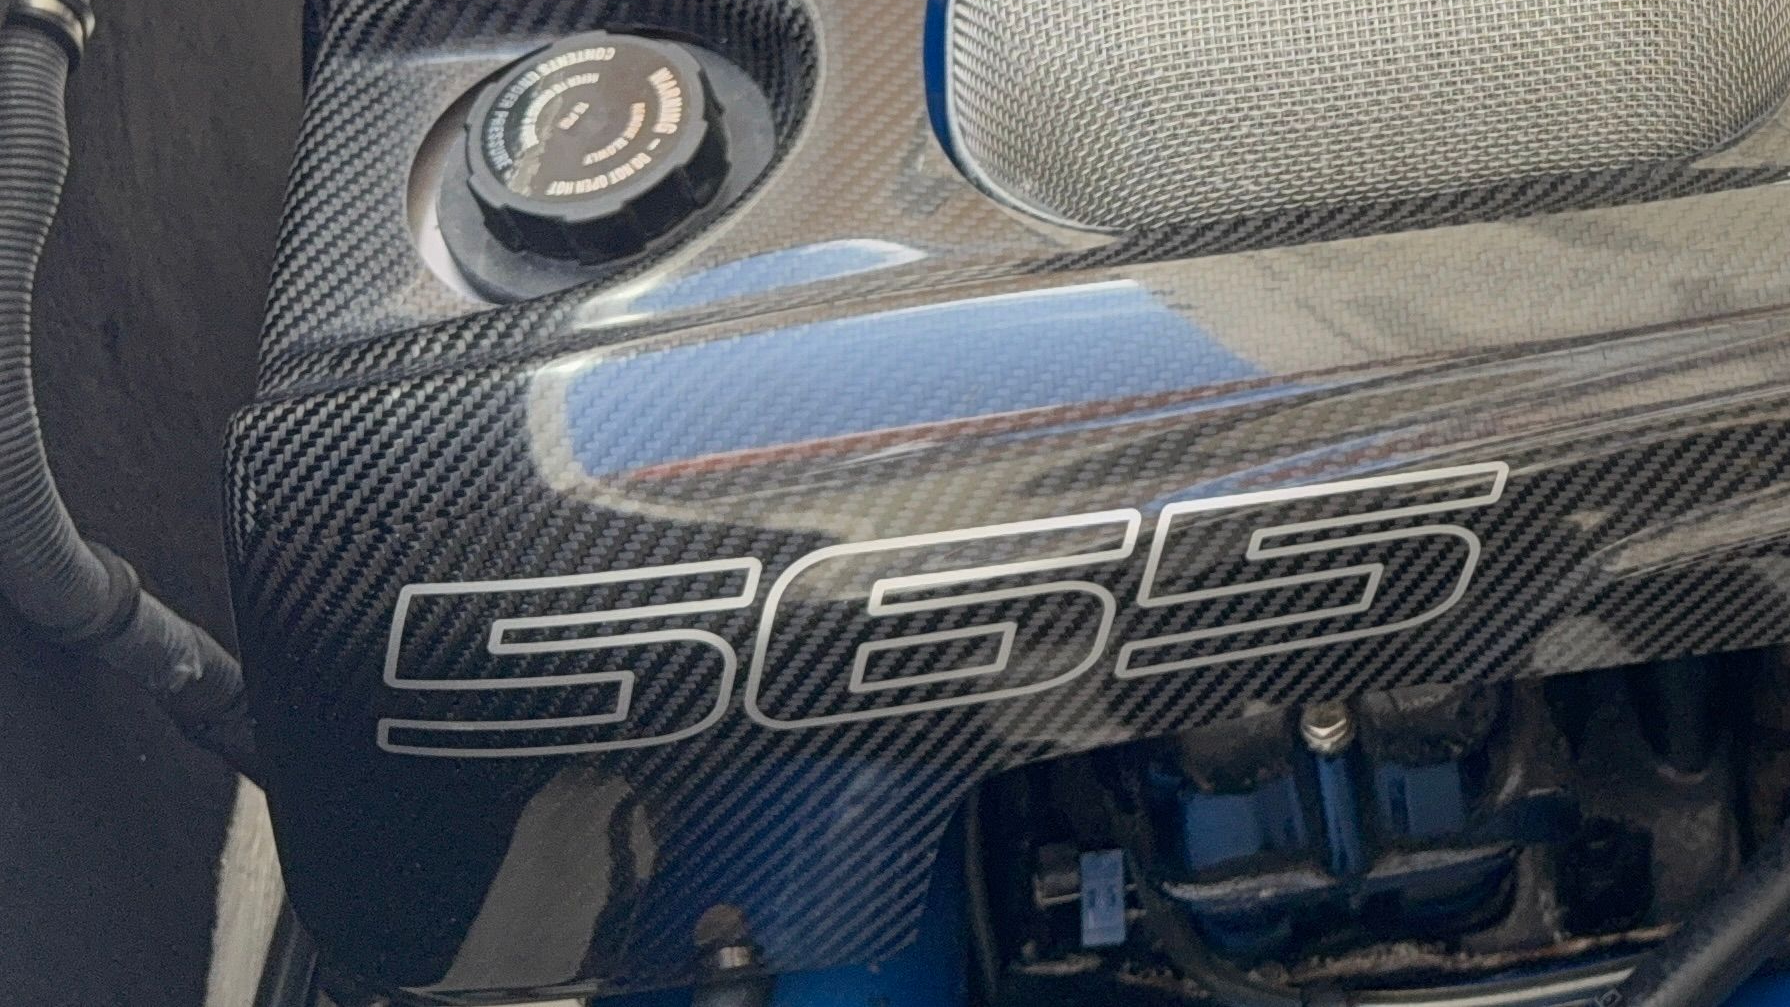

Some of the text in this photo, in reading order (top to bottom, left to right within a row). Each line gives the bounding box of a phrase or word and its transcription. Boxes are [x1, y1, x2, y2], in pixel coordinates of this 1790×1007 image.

[537, 47, 616, 77] CONTENTS
[498, 70, 541, 109] UNDER
[649, 67, 683, 135] WARNING
[487, 110, 513, 171] PRESSURE
[608, 163, 635, 186] NOT
[630, 152, 651, 171] DO
[546, 180, 574, 196] HOT
[576, 174, 609, 194] OPEN
[376, 461, 1510, 755] 565
